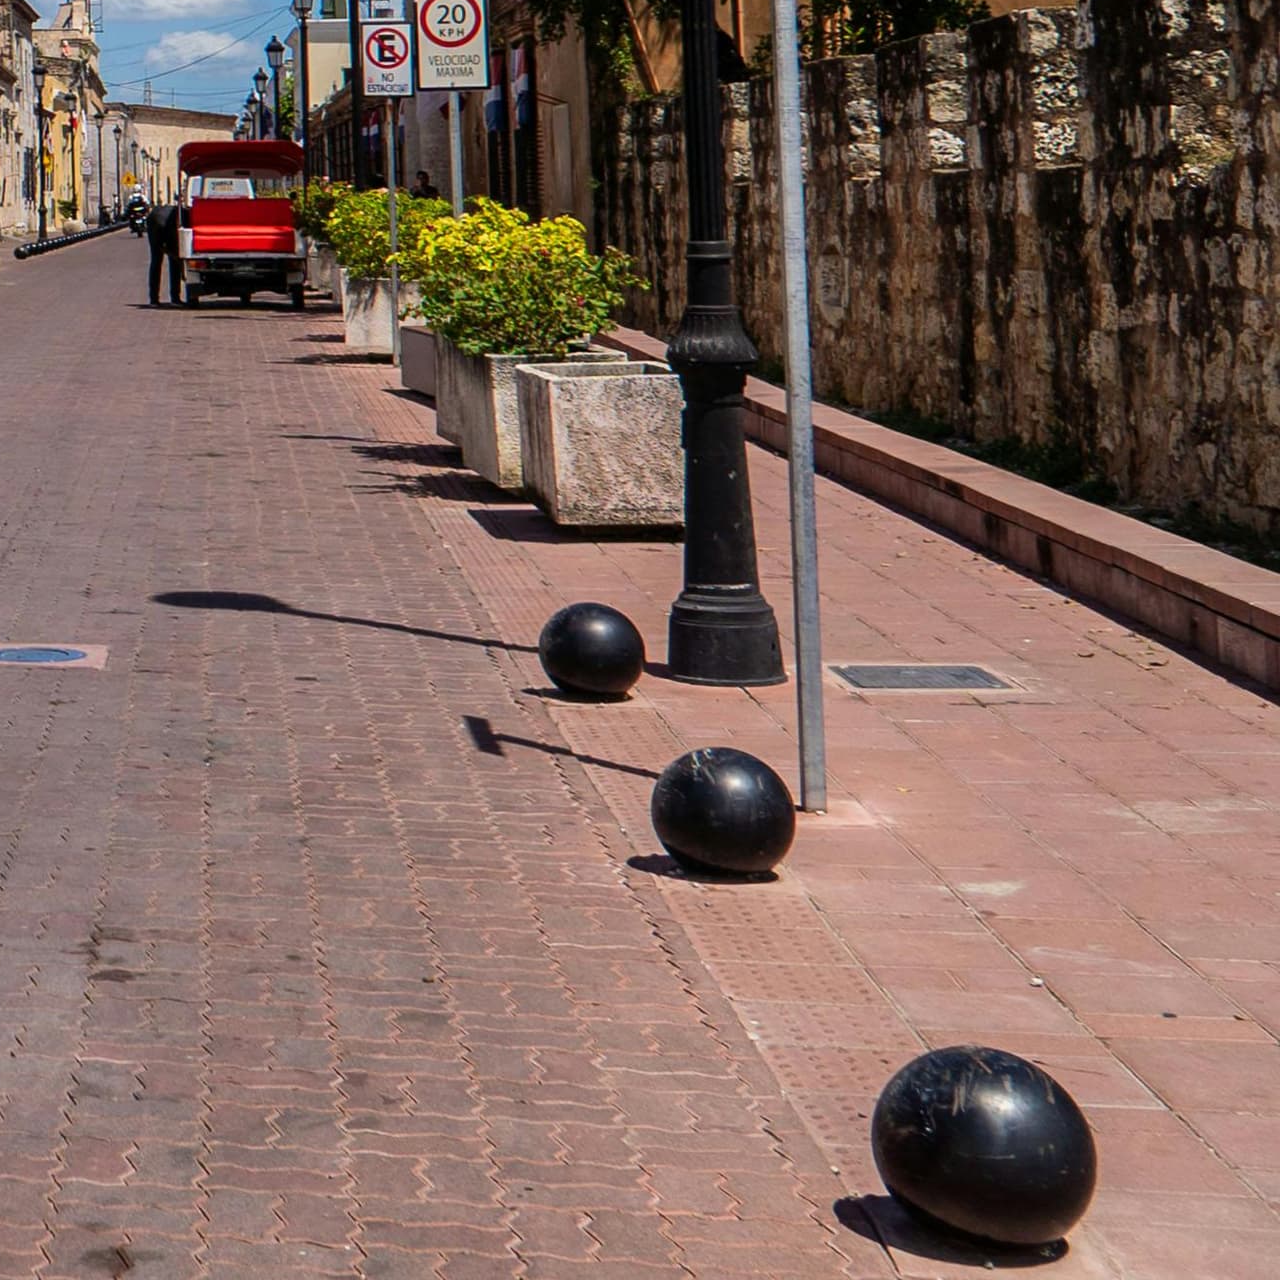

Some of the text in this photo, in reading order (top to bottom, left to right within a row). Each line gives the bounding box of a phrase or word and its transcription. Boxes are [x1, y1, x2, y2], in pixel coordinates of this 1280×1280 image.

[437, 5, 466, 25] 20
[439, 29, 464, 38] KPH
[378, 35, 397, 62] E
[428, 54, 481, 66] VELOCIDAD
[381, 73, 395, 83] NO
[436, 67, 474, 78] MAXIMA
